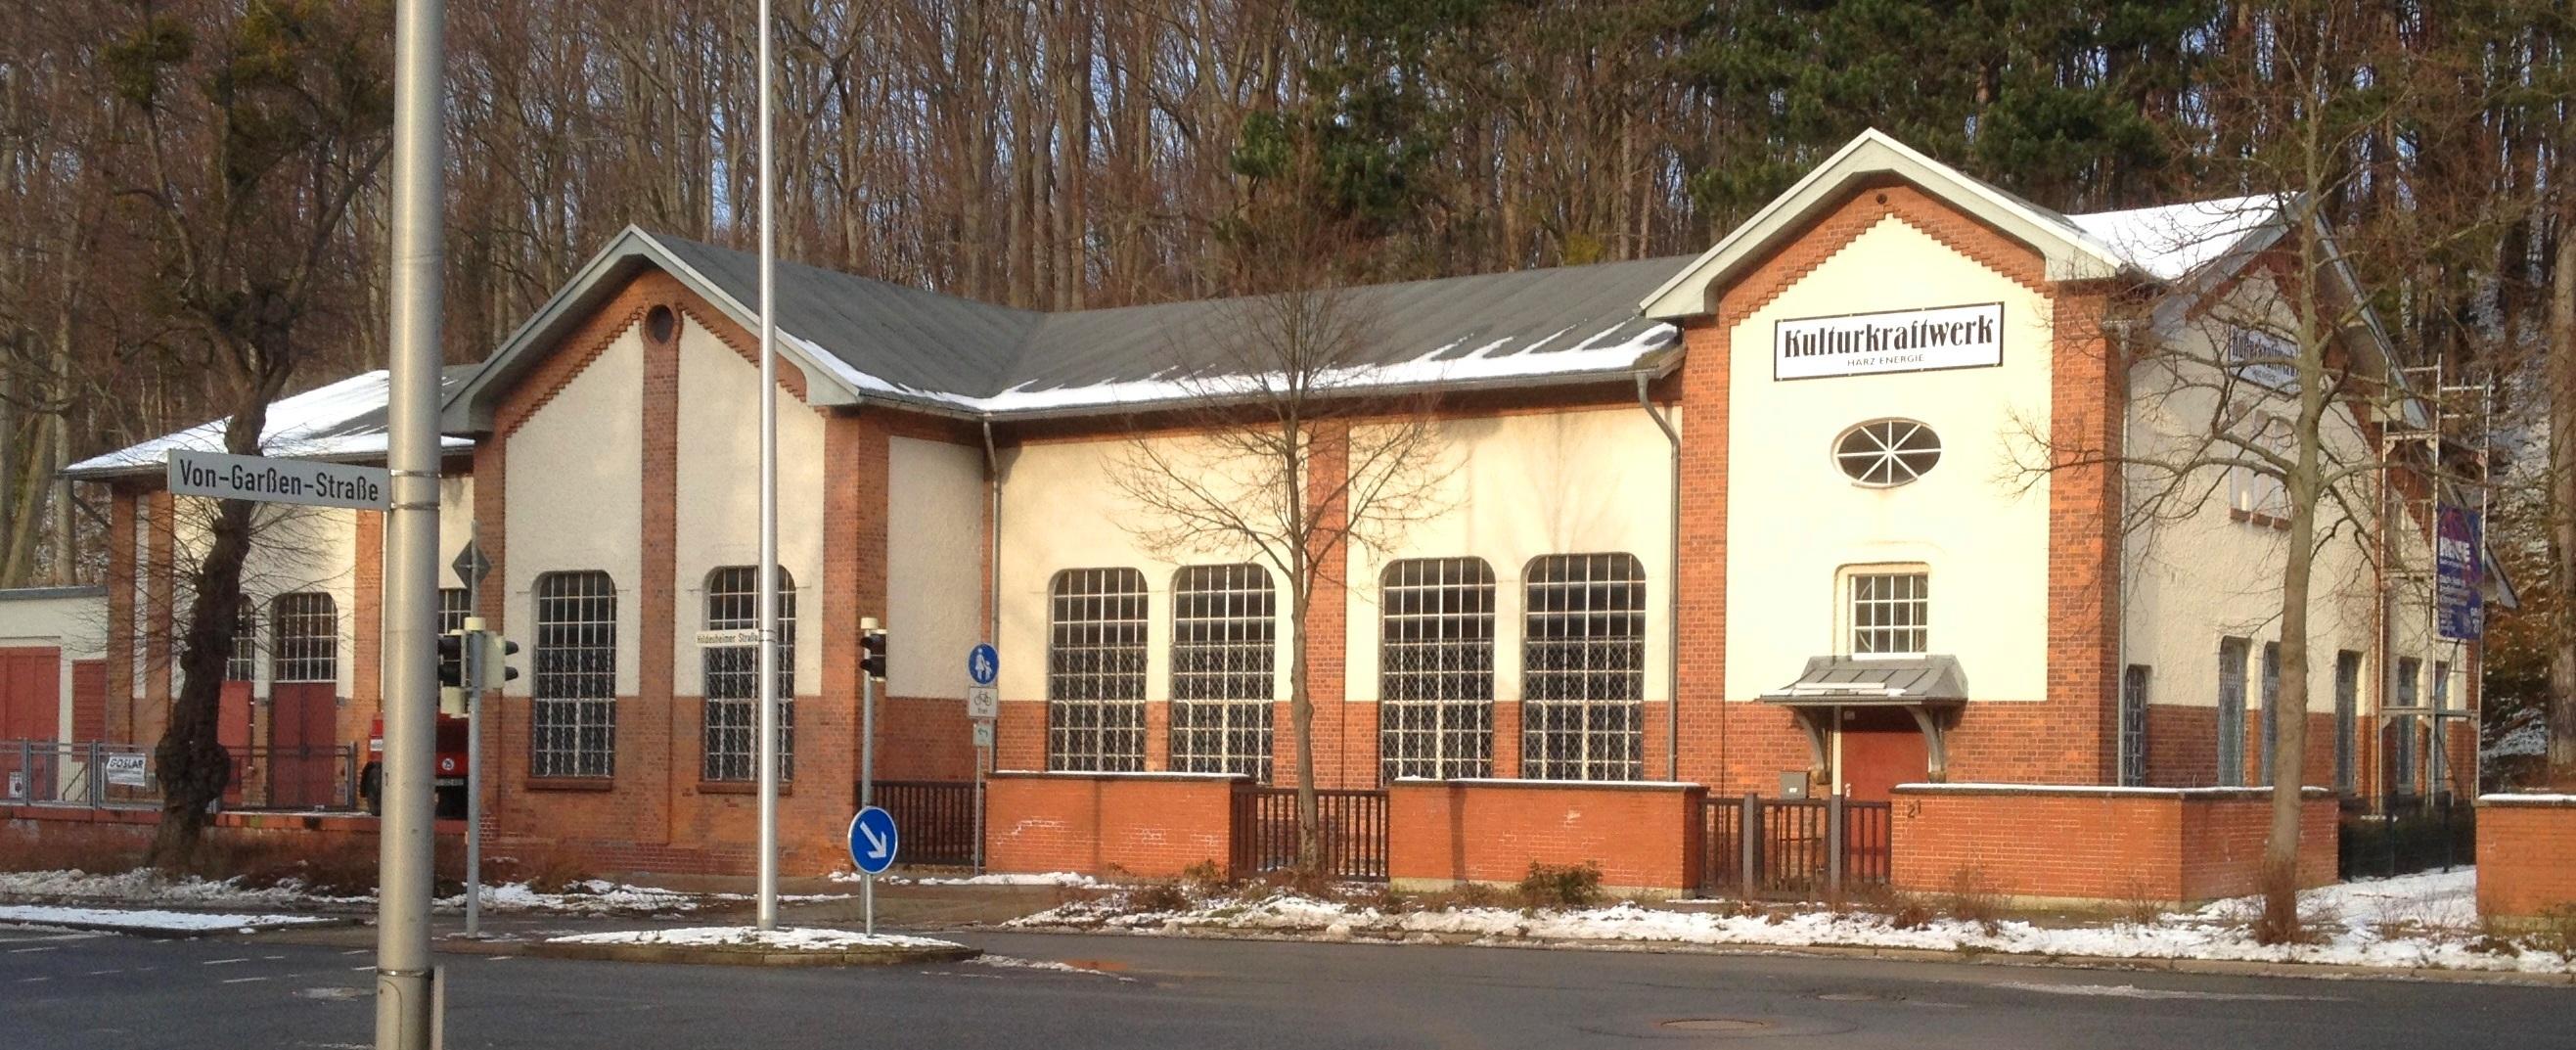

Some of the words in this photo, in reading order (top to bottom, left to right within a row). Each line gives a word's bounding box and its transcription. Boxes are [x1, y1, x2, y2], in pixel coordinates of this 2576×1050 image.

[1785, 314, 1994, 358] Kulturkraftwerk
[1847, 358, 1876, 367] HARZ
[1879, 353, 1925, 365] ENERGIE
[179, 458, 379, 502] Von-Garßen-Straße
[697, 634, 737, 644] Hildesheimer
[110, 757, 144, 769] GOSLAR
[1908, 799, 1921, 819] 21
